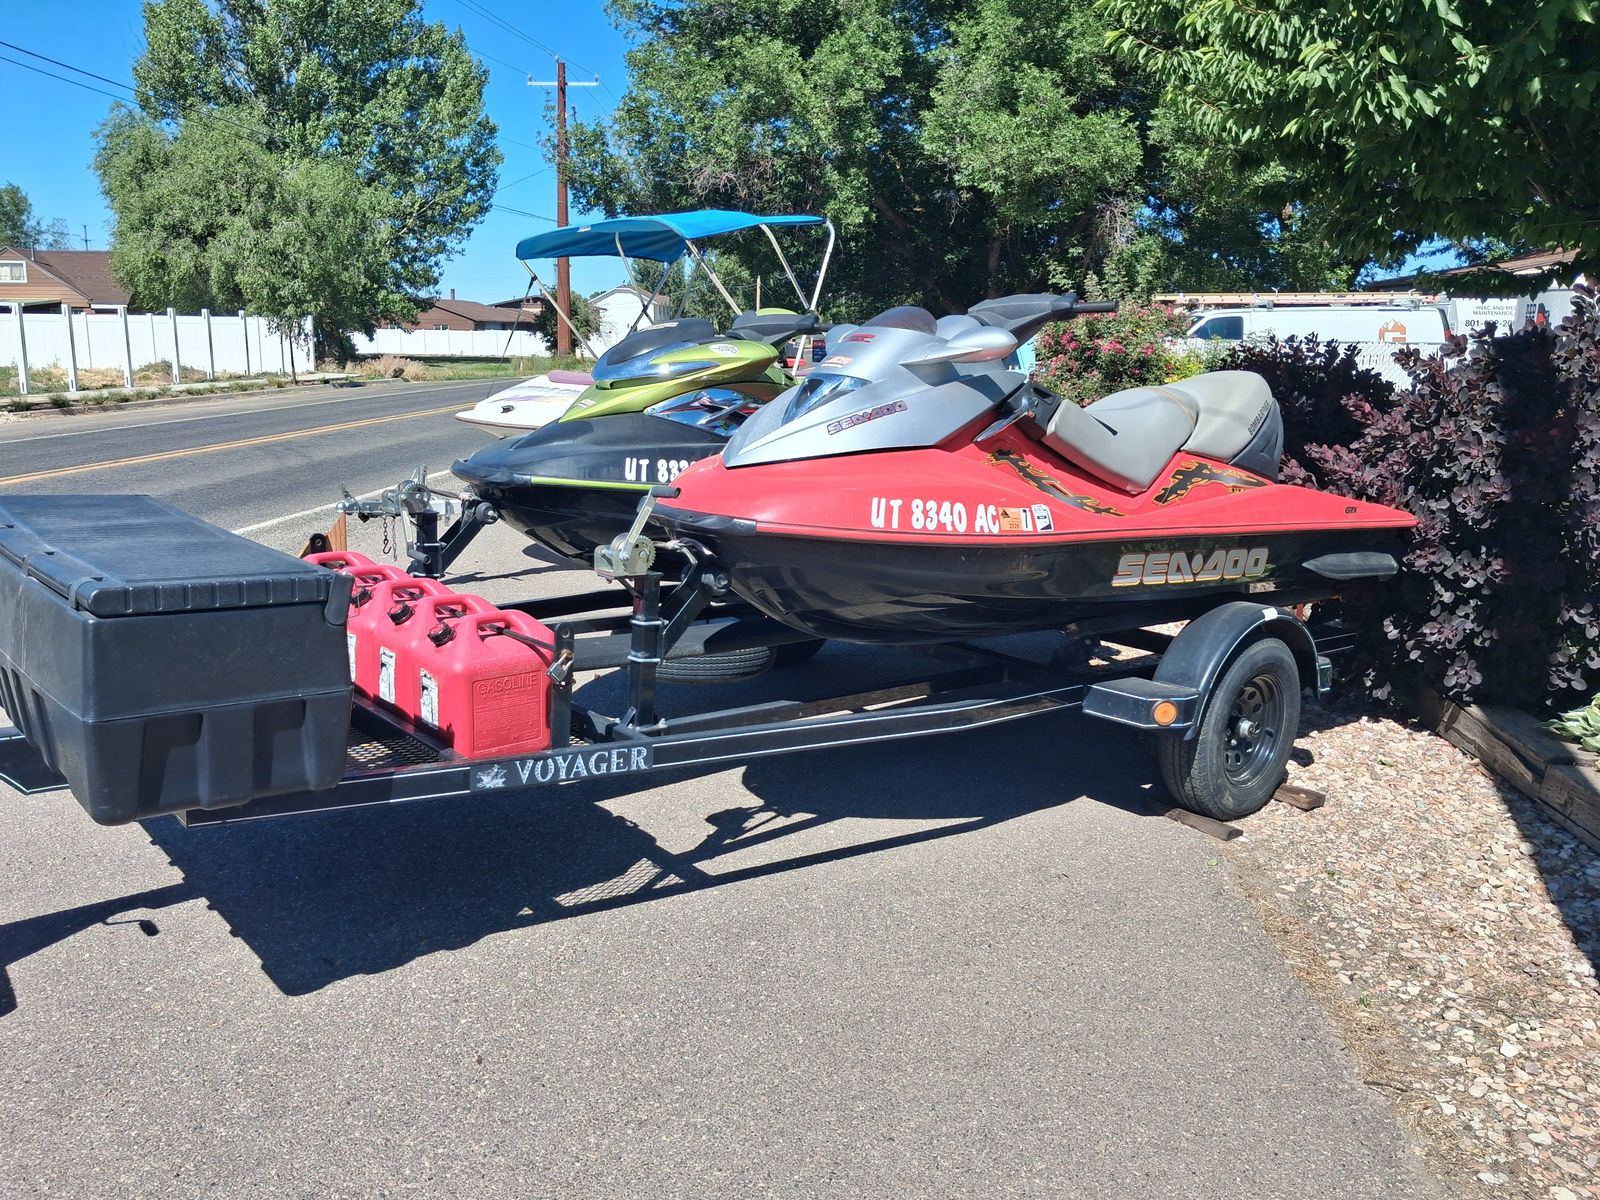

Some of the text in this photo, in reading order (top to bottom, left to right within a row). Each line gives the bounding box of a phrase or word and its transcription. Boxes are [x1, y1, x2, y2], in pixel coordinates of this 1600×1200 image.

[624, 457, 650, 482] UT
[871, 497, 903, 529] UT
[911, 498, 967, 533] 8340
[974, 503, 1000, 534] AC
[478, 674, 537, 694] GASOLINE
[515, 746, 648, 784] VOYAGER
